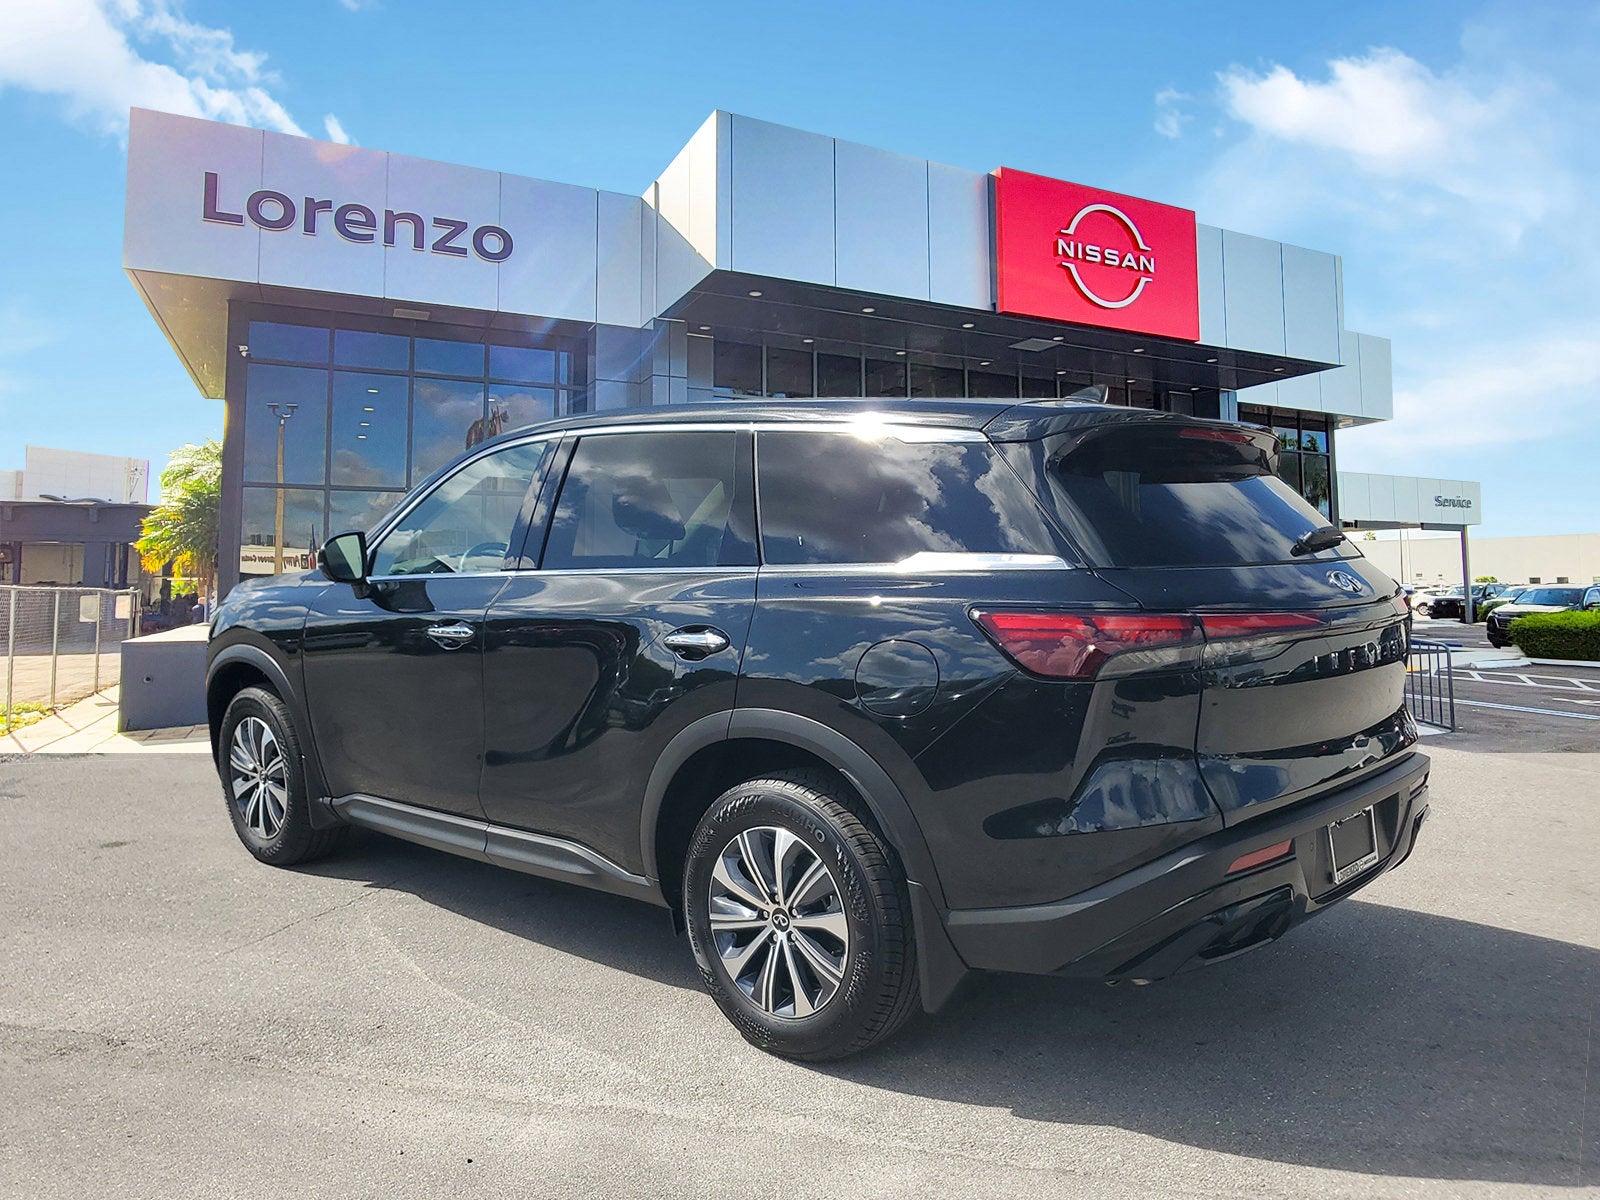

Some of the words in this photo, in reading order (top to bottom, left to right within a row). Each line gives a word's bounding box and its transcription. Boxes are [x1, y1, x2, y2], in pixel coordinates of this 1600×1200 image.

[202, 171, 514, 262] Lorenzo
[1057, 238, 1155, 273] NISSAN
[1434, 495, 1472, 508] Service
